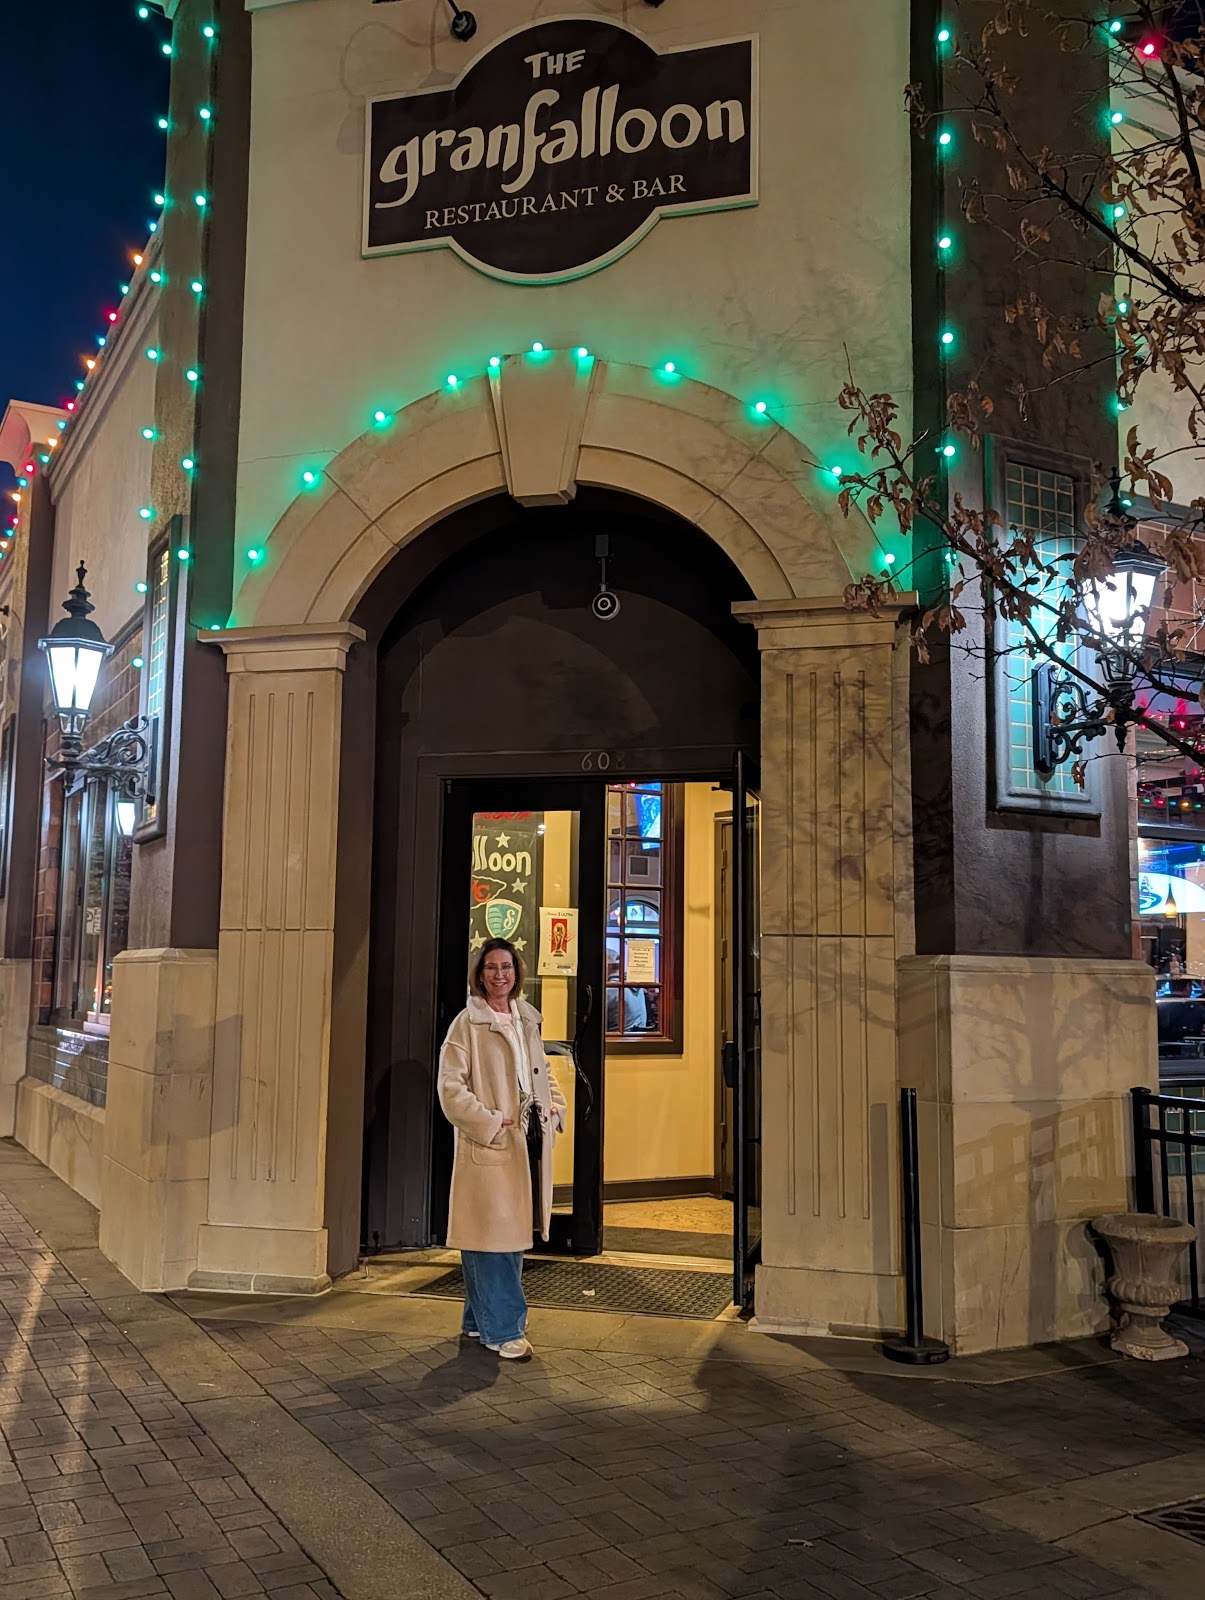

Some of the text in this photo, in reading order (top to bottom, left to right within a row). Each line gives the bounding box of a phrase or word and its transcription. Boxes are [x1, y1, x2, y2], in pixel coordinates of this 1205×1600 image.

[524, 49, 586, 79] THE
[374, 83, 745, 210] granfalloon
[424, 174, 687, 230] RESTAURANT & BAR
[472, 835, 531, 876] lloon
